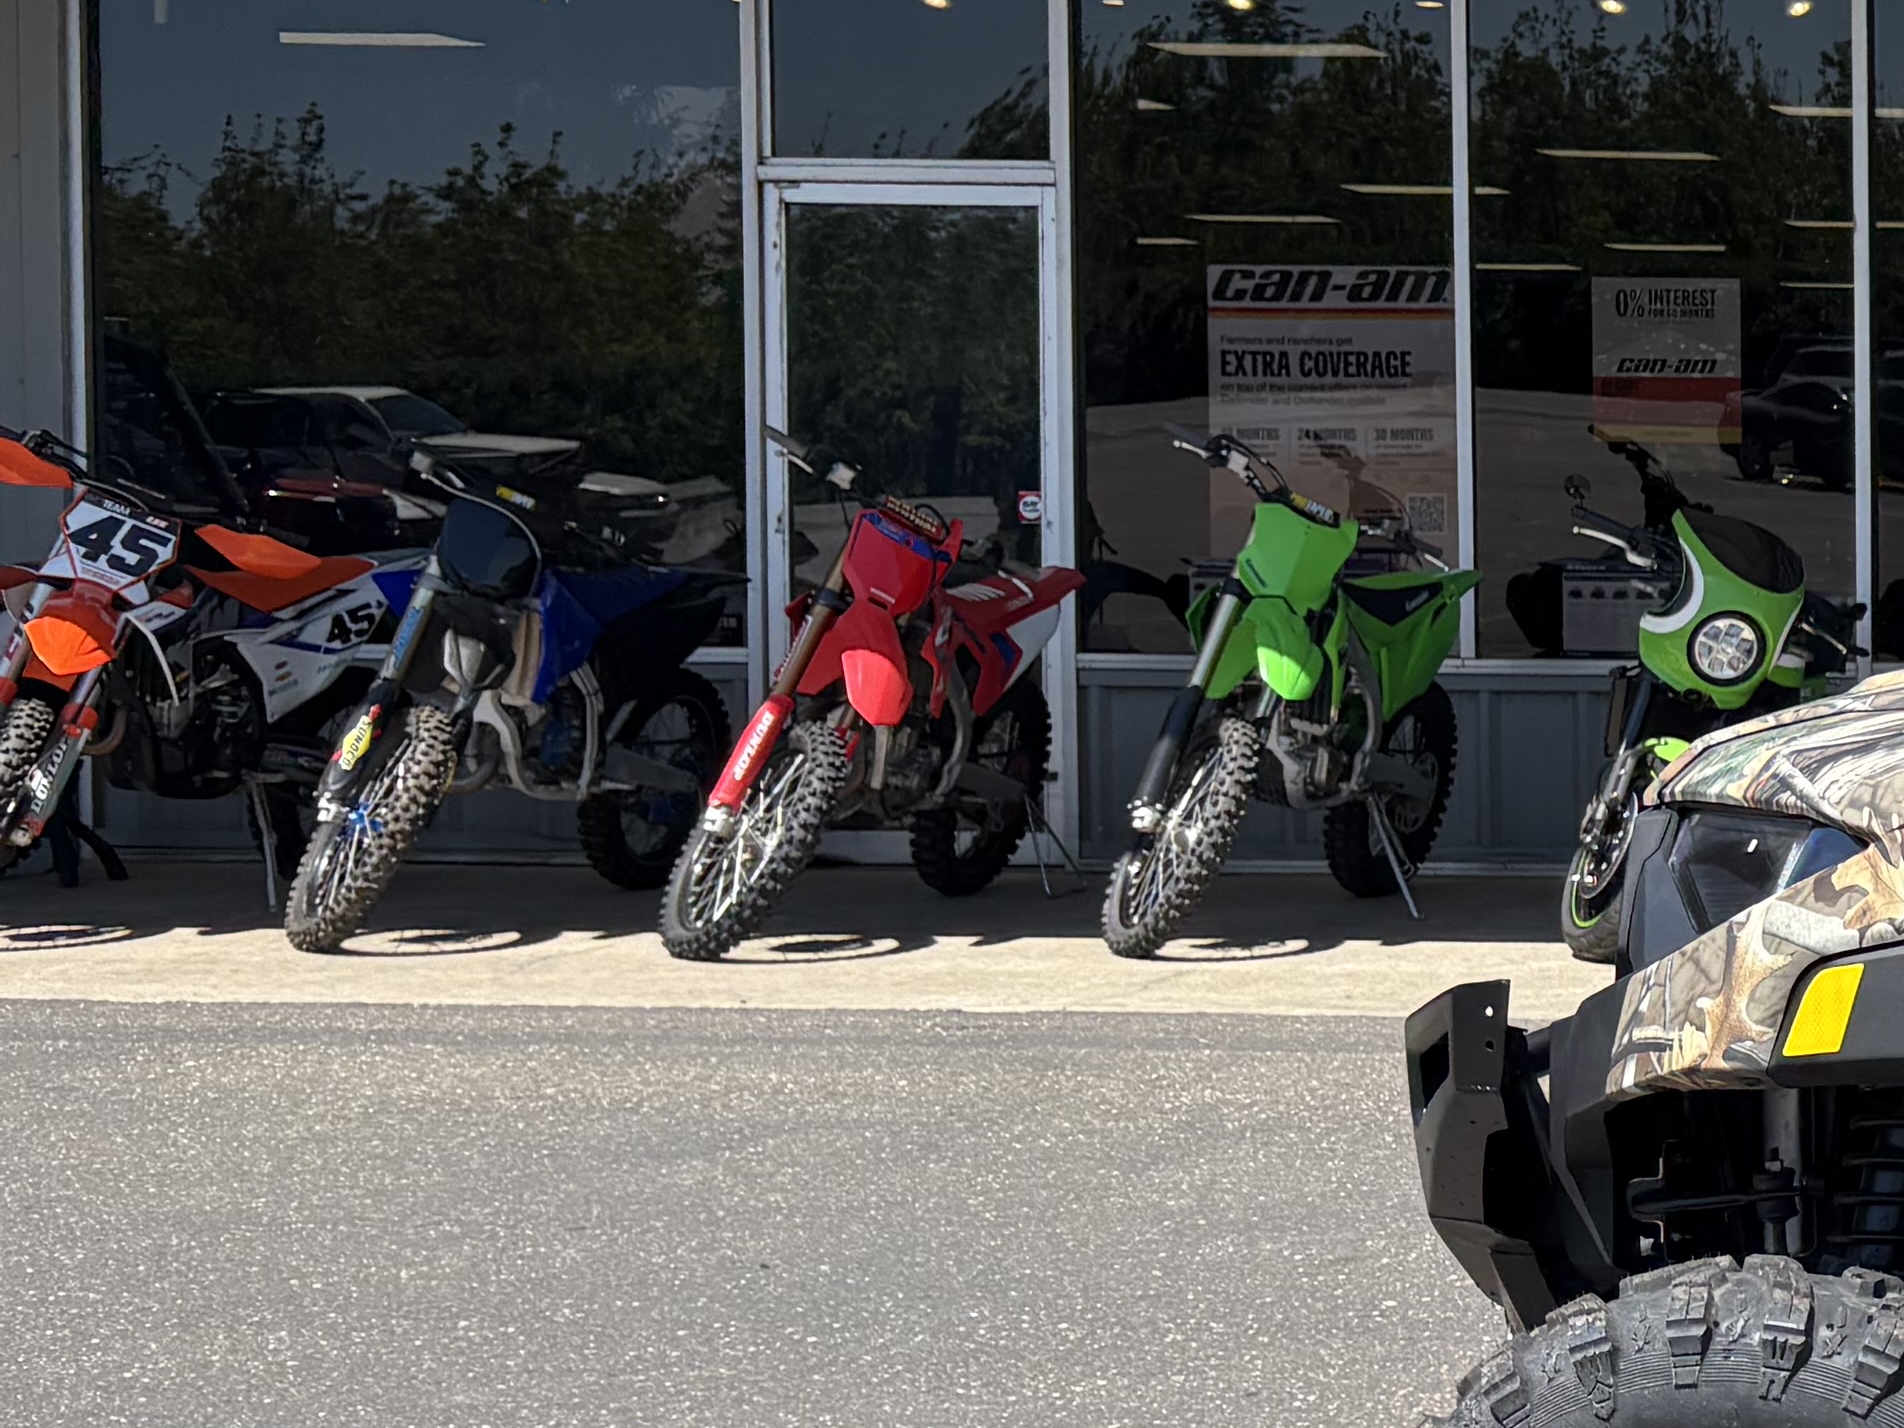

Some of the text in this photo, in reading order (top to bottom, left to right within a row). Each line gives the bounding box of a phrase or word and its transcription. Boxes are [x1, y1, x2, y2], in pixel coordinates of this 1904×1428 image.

[1615, 288, 1717, 318] 0% INTEREST
[1265, 335, 1285, 346] and
[1220, 349, 1413, 378] EXTRA COVERAGE
[1616, 358, 1718, 374] can-am
[69, 515, 172, 576] 45
[326, 602, 376, 644] 45
[341, 720, 372, 767] SUNOCO
[734, 711, 774, 781] DUNLOP
